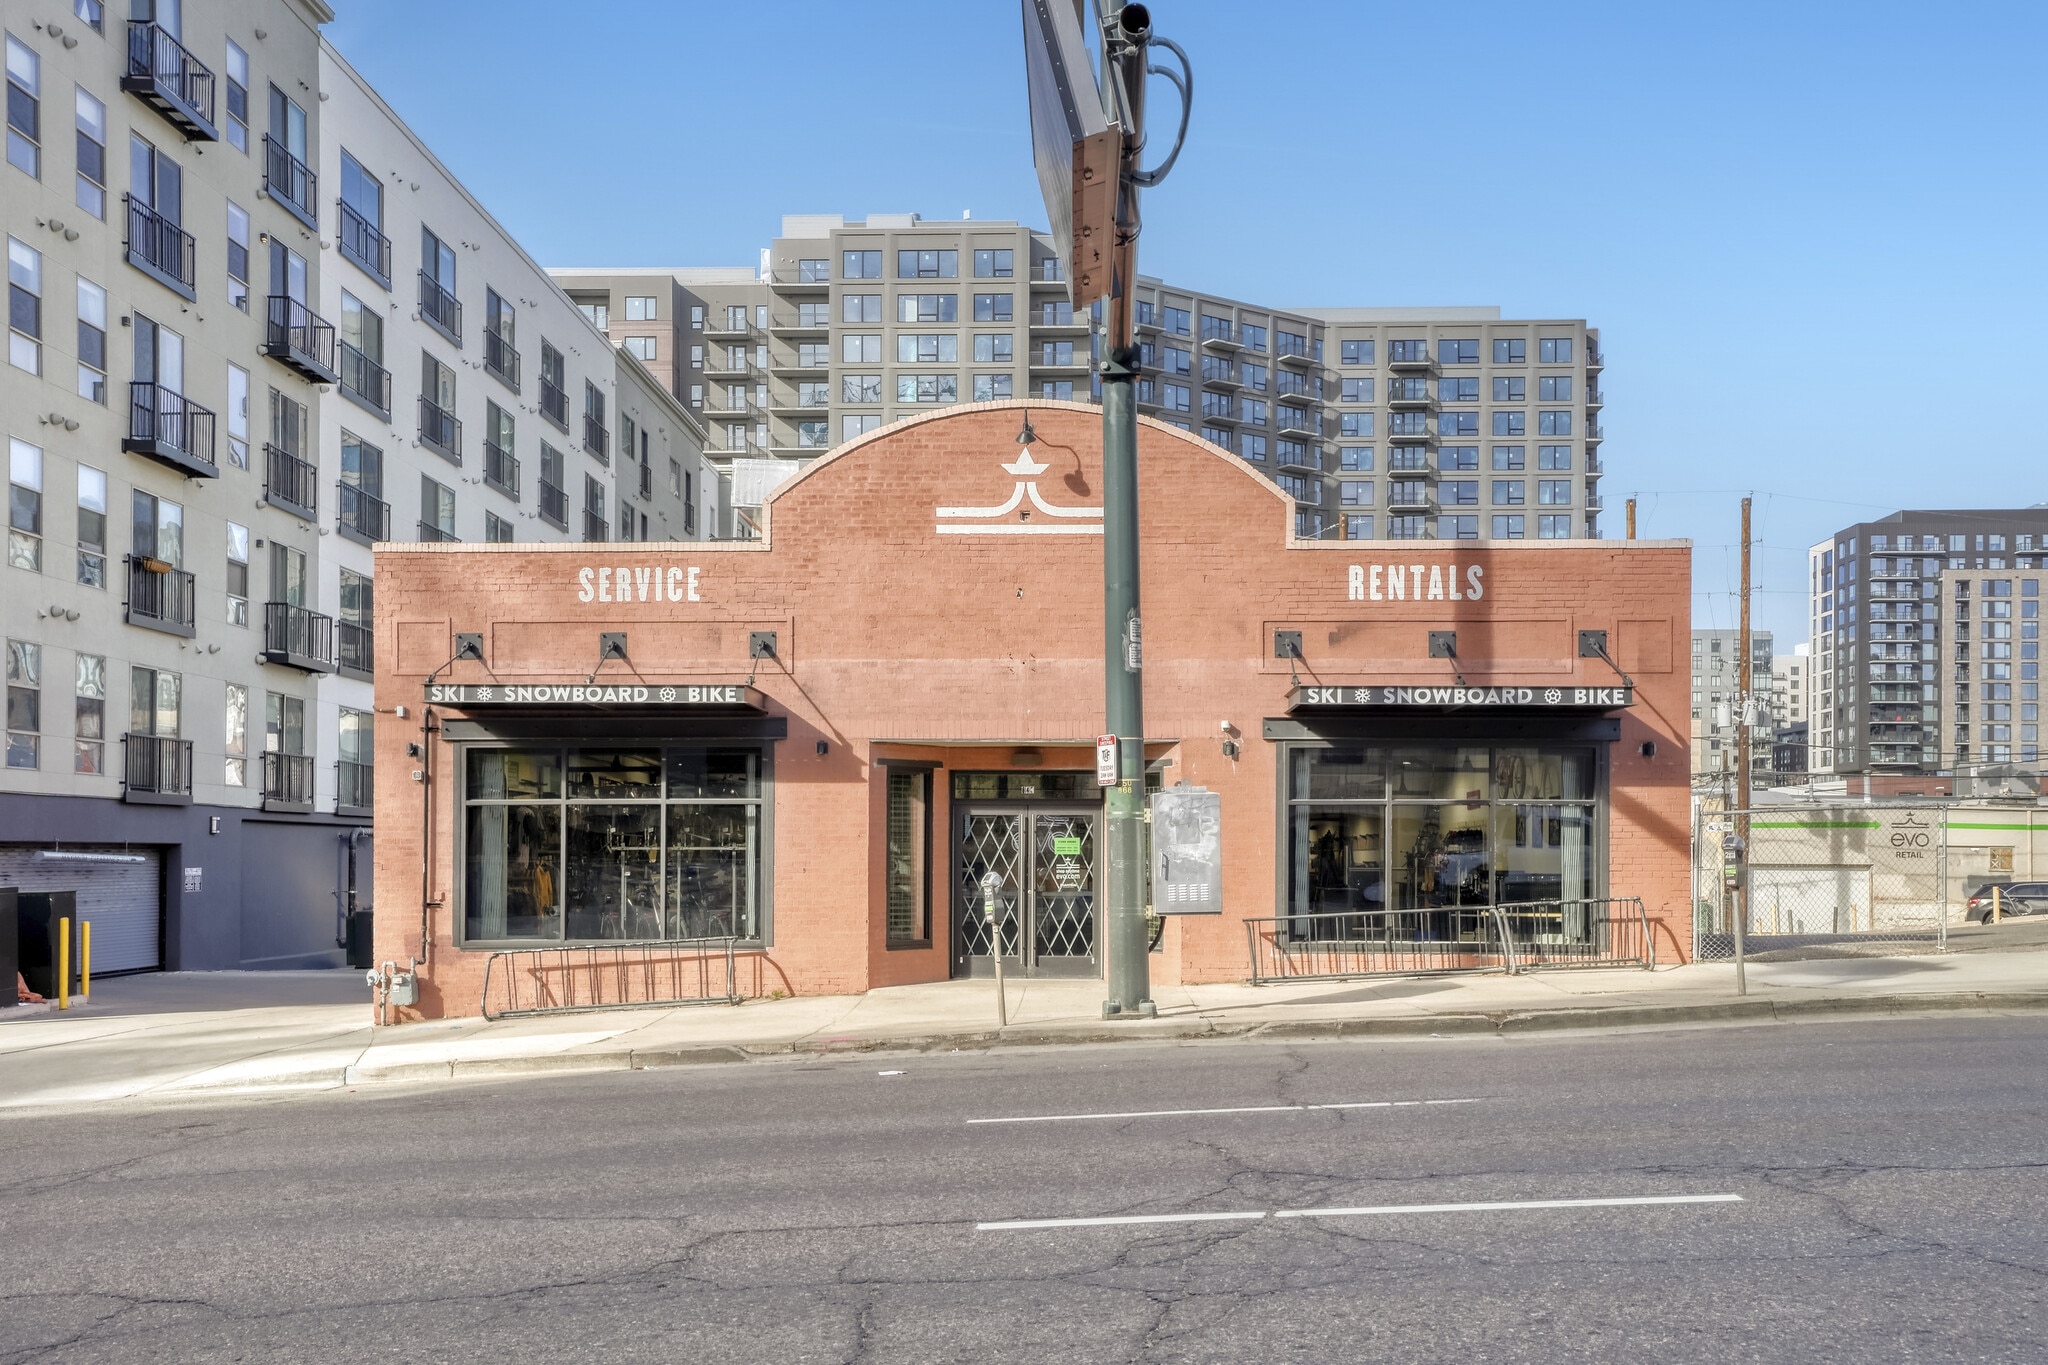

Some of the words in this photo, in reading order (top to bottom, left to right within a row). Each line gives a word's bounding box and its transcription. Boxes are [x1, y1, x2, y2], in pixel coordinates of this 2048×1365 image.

[578, 566, 701, 602] SERVICE
[1348, 564, 1484, 601] RENTALS
[431, 686, 465, 702] SKI
[504, 686, 649, 703] SNOWBOARD
[688, 686, 737, 702] BIKE
[1307, 687, 1342, 704] SKI
[1383, 687, 1533, 704] SNOWBOARD
[1574, 687, 1625, 705] BIKE
[1890, 832, 1930, 848] evo
[1895, 851, 1924, 859] RETAIL
